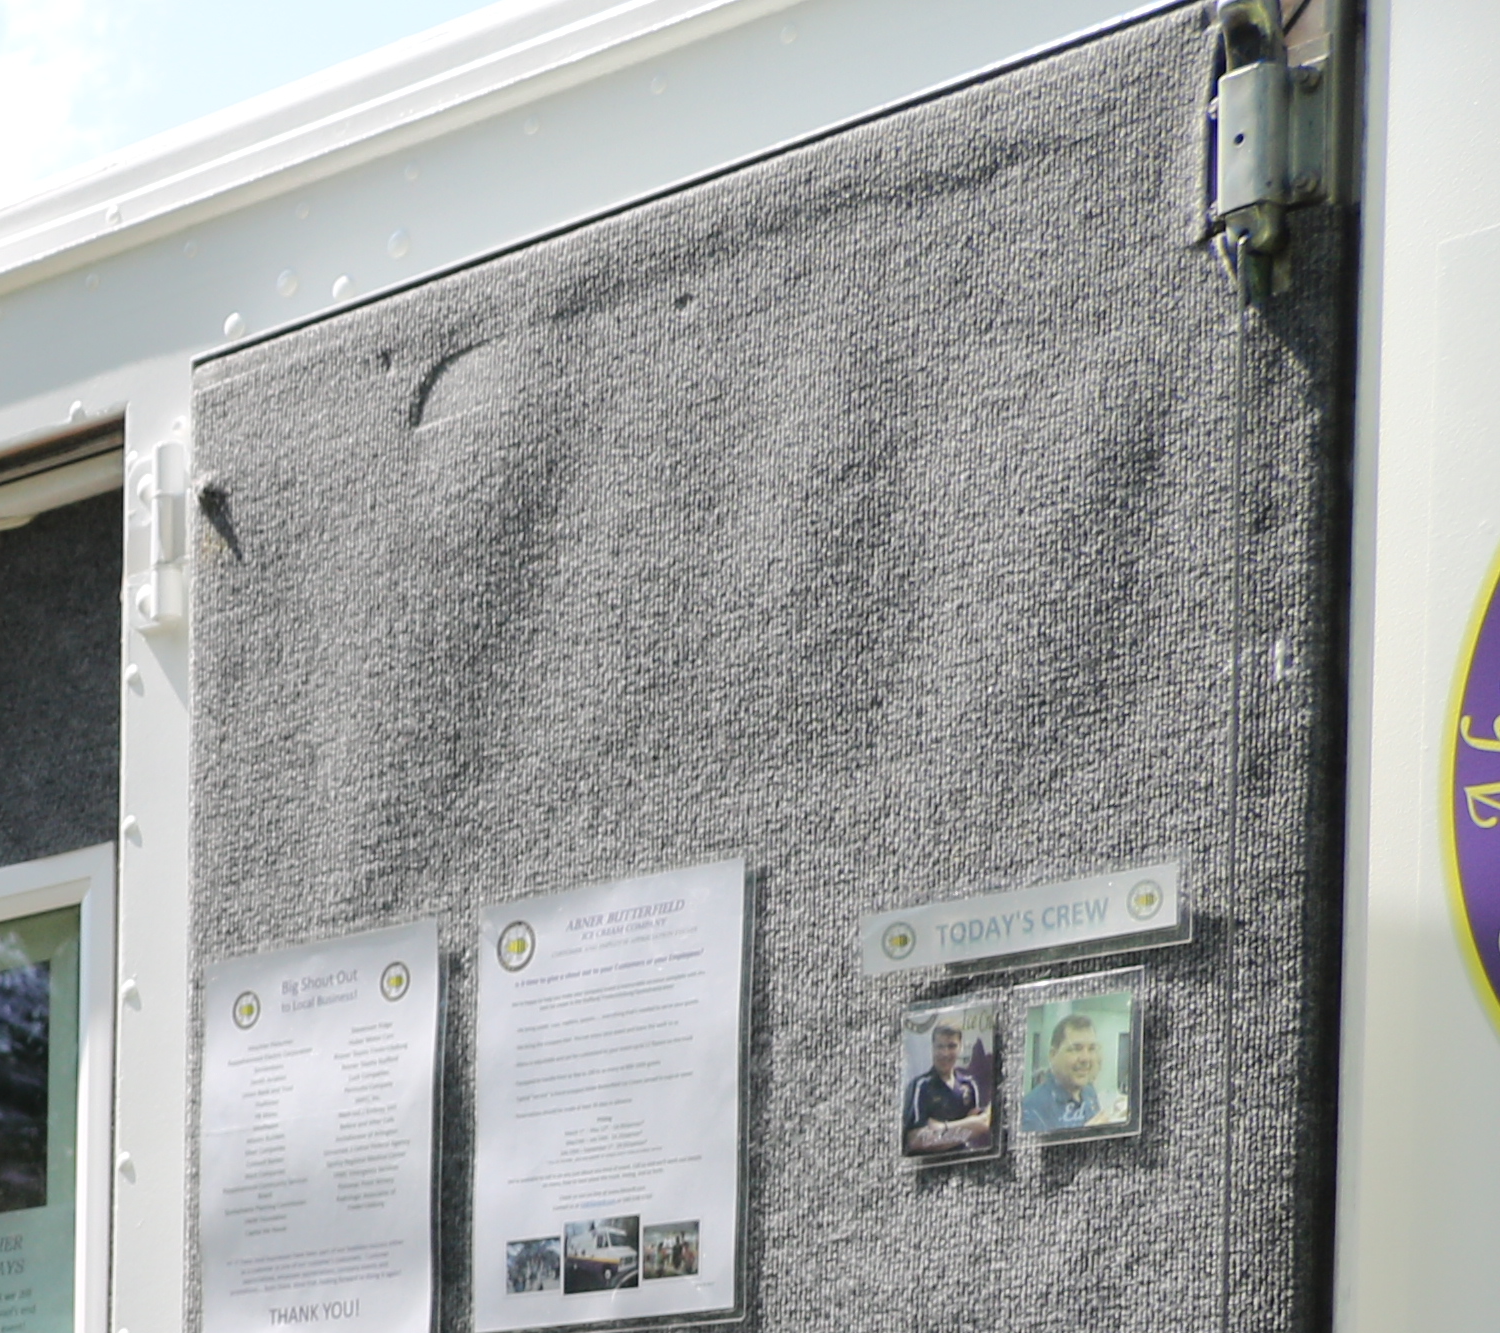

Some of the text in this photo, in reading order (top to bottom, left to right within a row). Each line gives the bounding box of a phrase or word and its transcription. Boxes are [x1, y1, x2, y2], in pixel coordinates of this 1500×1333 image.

[565, 899, 686, 932] ABNER BUTTERFIELD
[581, 931, 594, 941] ICE
[596, 925, 624, 939] CREAM
[626, 917, 668, 934] COMPANY
[935, 898, 1110, 948] TODAY'S CREW
[282, 969, 358, 996] Big Shout Out
[281, 1002, 291, 1012] to
[292, 996, 315, 1011] Local
[1059, 1101, 1086, 1122] Ed
[269, 1298, 360, 1325] THANK YOU!
